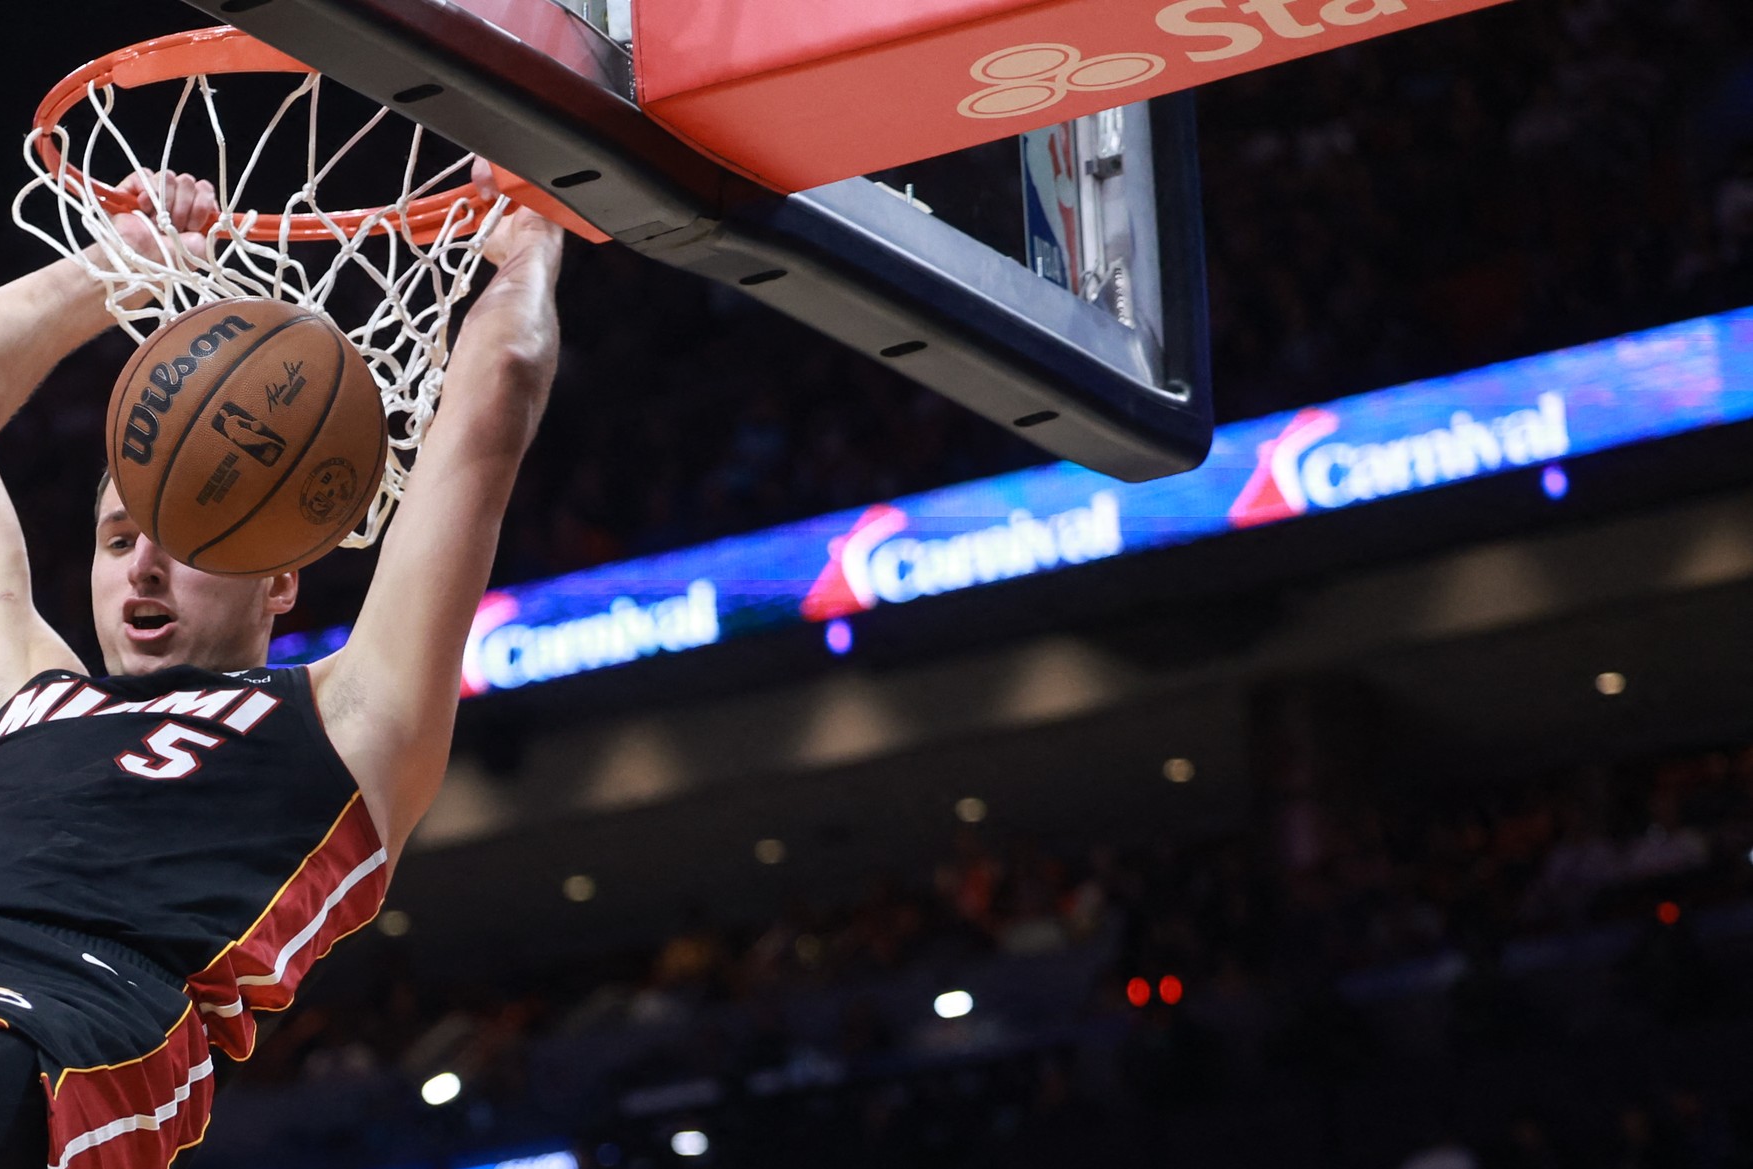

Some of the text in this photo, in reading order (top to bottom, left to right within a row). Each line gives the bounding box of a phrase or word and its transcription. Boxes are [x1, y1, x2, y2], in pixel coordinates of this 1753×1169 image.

[1154, 0, 1454, 63] Sta
[122, 315, 256, 466] Wilson
[1301, 391, 1569, 508] Carnival
[870, 490, 1123, 603] Carnival
[481, 578, 719, 690] Carnival
[113, 719, 227, 780] 5
